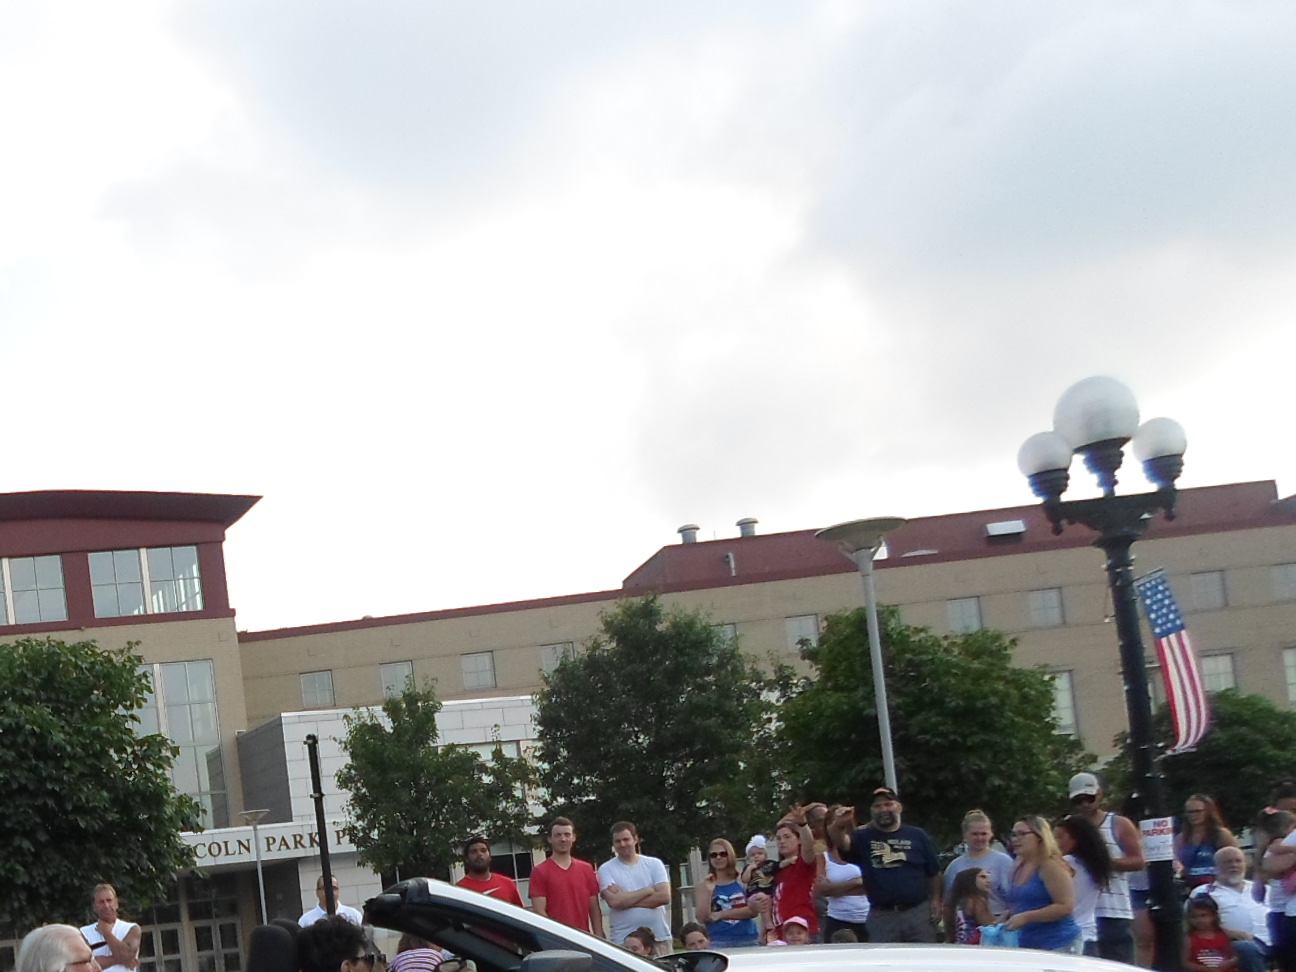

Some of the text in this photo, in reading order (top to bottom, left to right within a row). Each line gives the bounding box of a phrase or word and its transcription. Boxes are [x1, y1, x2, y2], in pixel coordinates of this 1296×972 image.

[1153, 820, 1168, 828] NO
[193, 838, 251, 858] COLN
[265, 831, 320, 852] PARK
